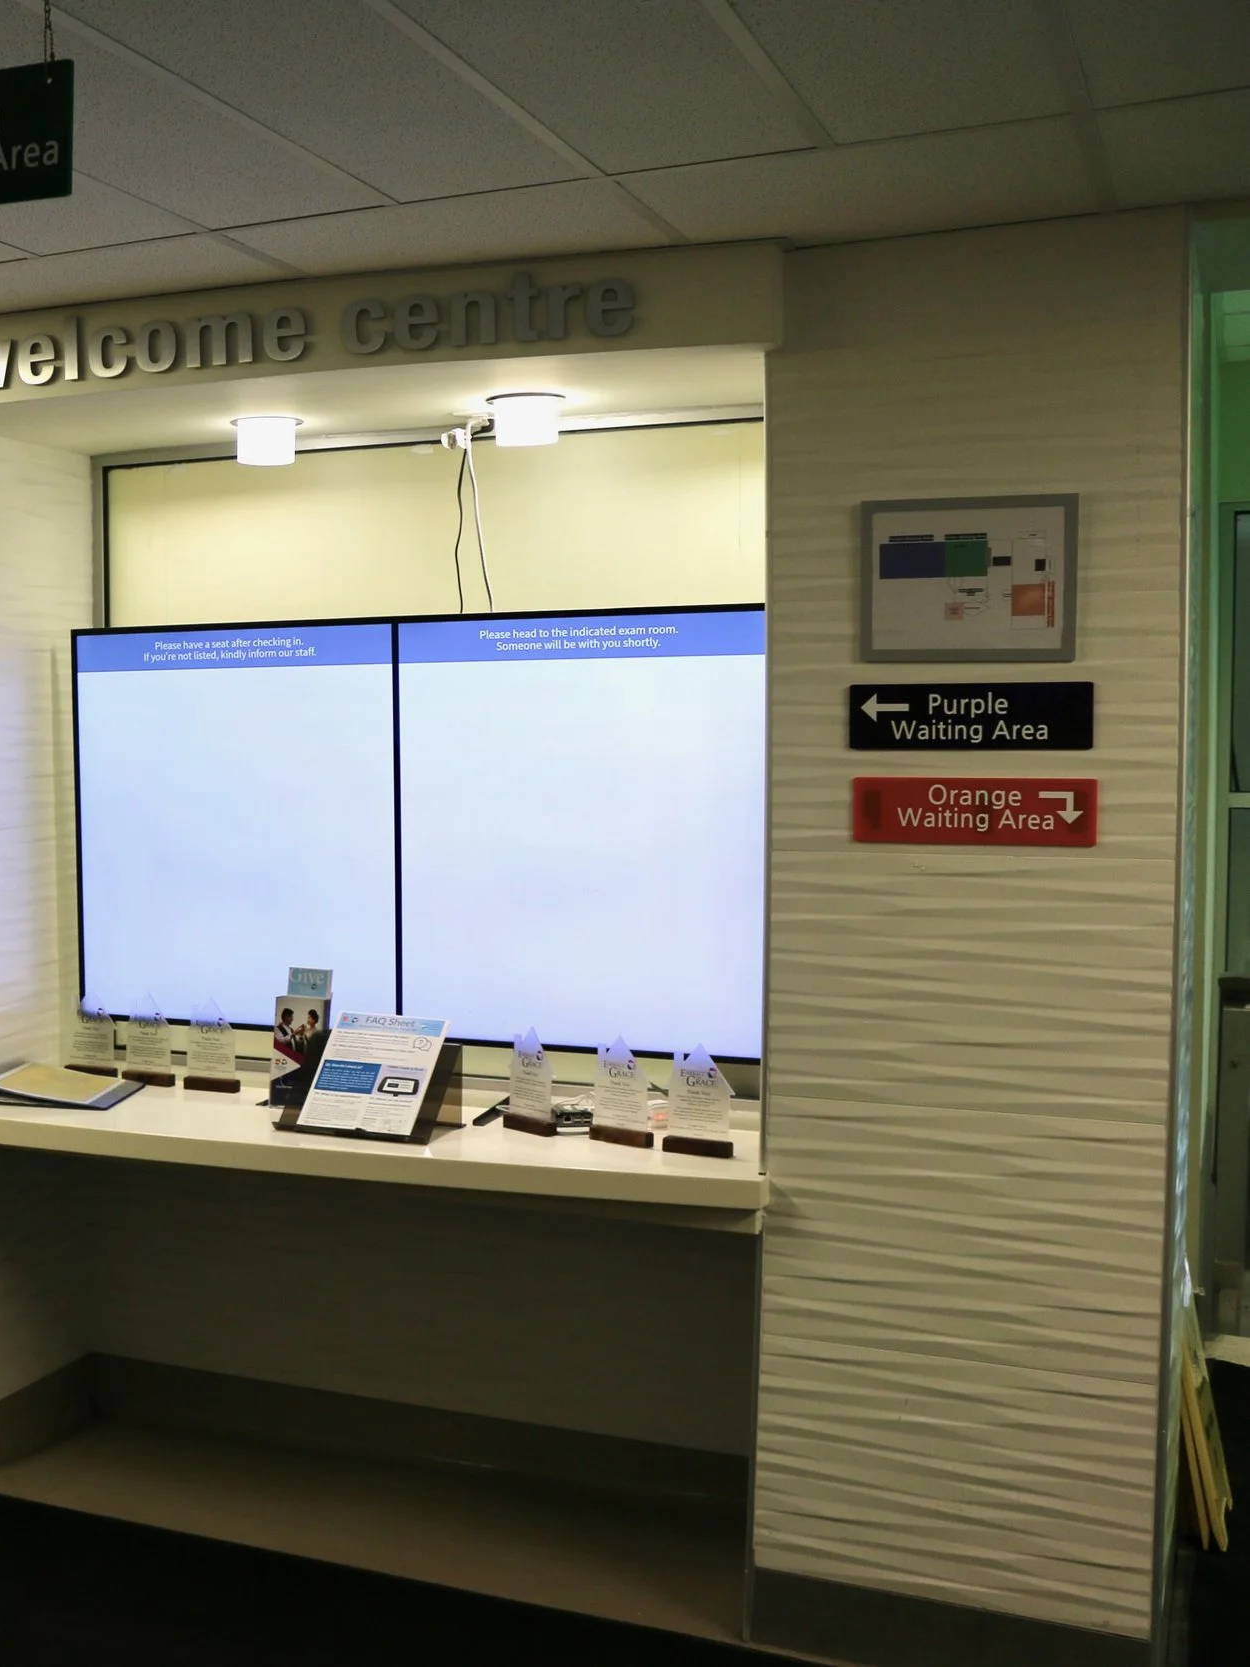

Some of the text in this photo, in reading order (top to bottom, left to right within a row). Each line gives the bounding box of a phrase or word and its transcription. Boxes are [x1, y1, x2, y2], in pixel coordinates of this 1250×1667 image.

[344, 270, 637, 356] centre
[480, 626, 679, 640] Please head to the indicated exam room.
[155, 641, 182, 650] Please
[183, 640, 203, 650] have
[212, 639, 230, 648] seat
[231, 638, 251, 647] after
[253, 637, 291, 648] checking
[293, 636, 304, 646] in.
[496, 637, 661, 651] Someone will be with you shortly.
[144, 647, 317, 663] If you're not listed, kindly inform our staff.
[927, 691, 1009, 718] Purple
[891, 719, 1049, 743] Waiting Area
[928, 784, 1022, 809] Orange
[897, 807, 1055, 832] Waiting Area
[289, 967, 325, 985] Give
[365, 1016, 387, 1026] FAQ
[388, 1017, 416, 1028] Sheet
